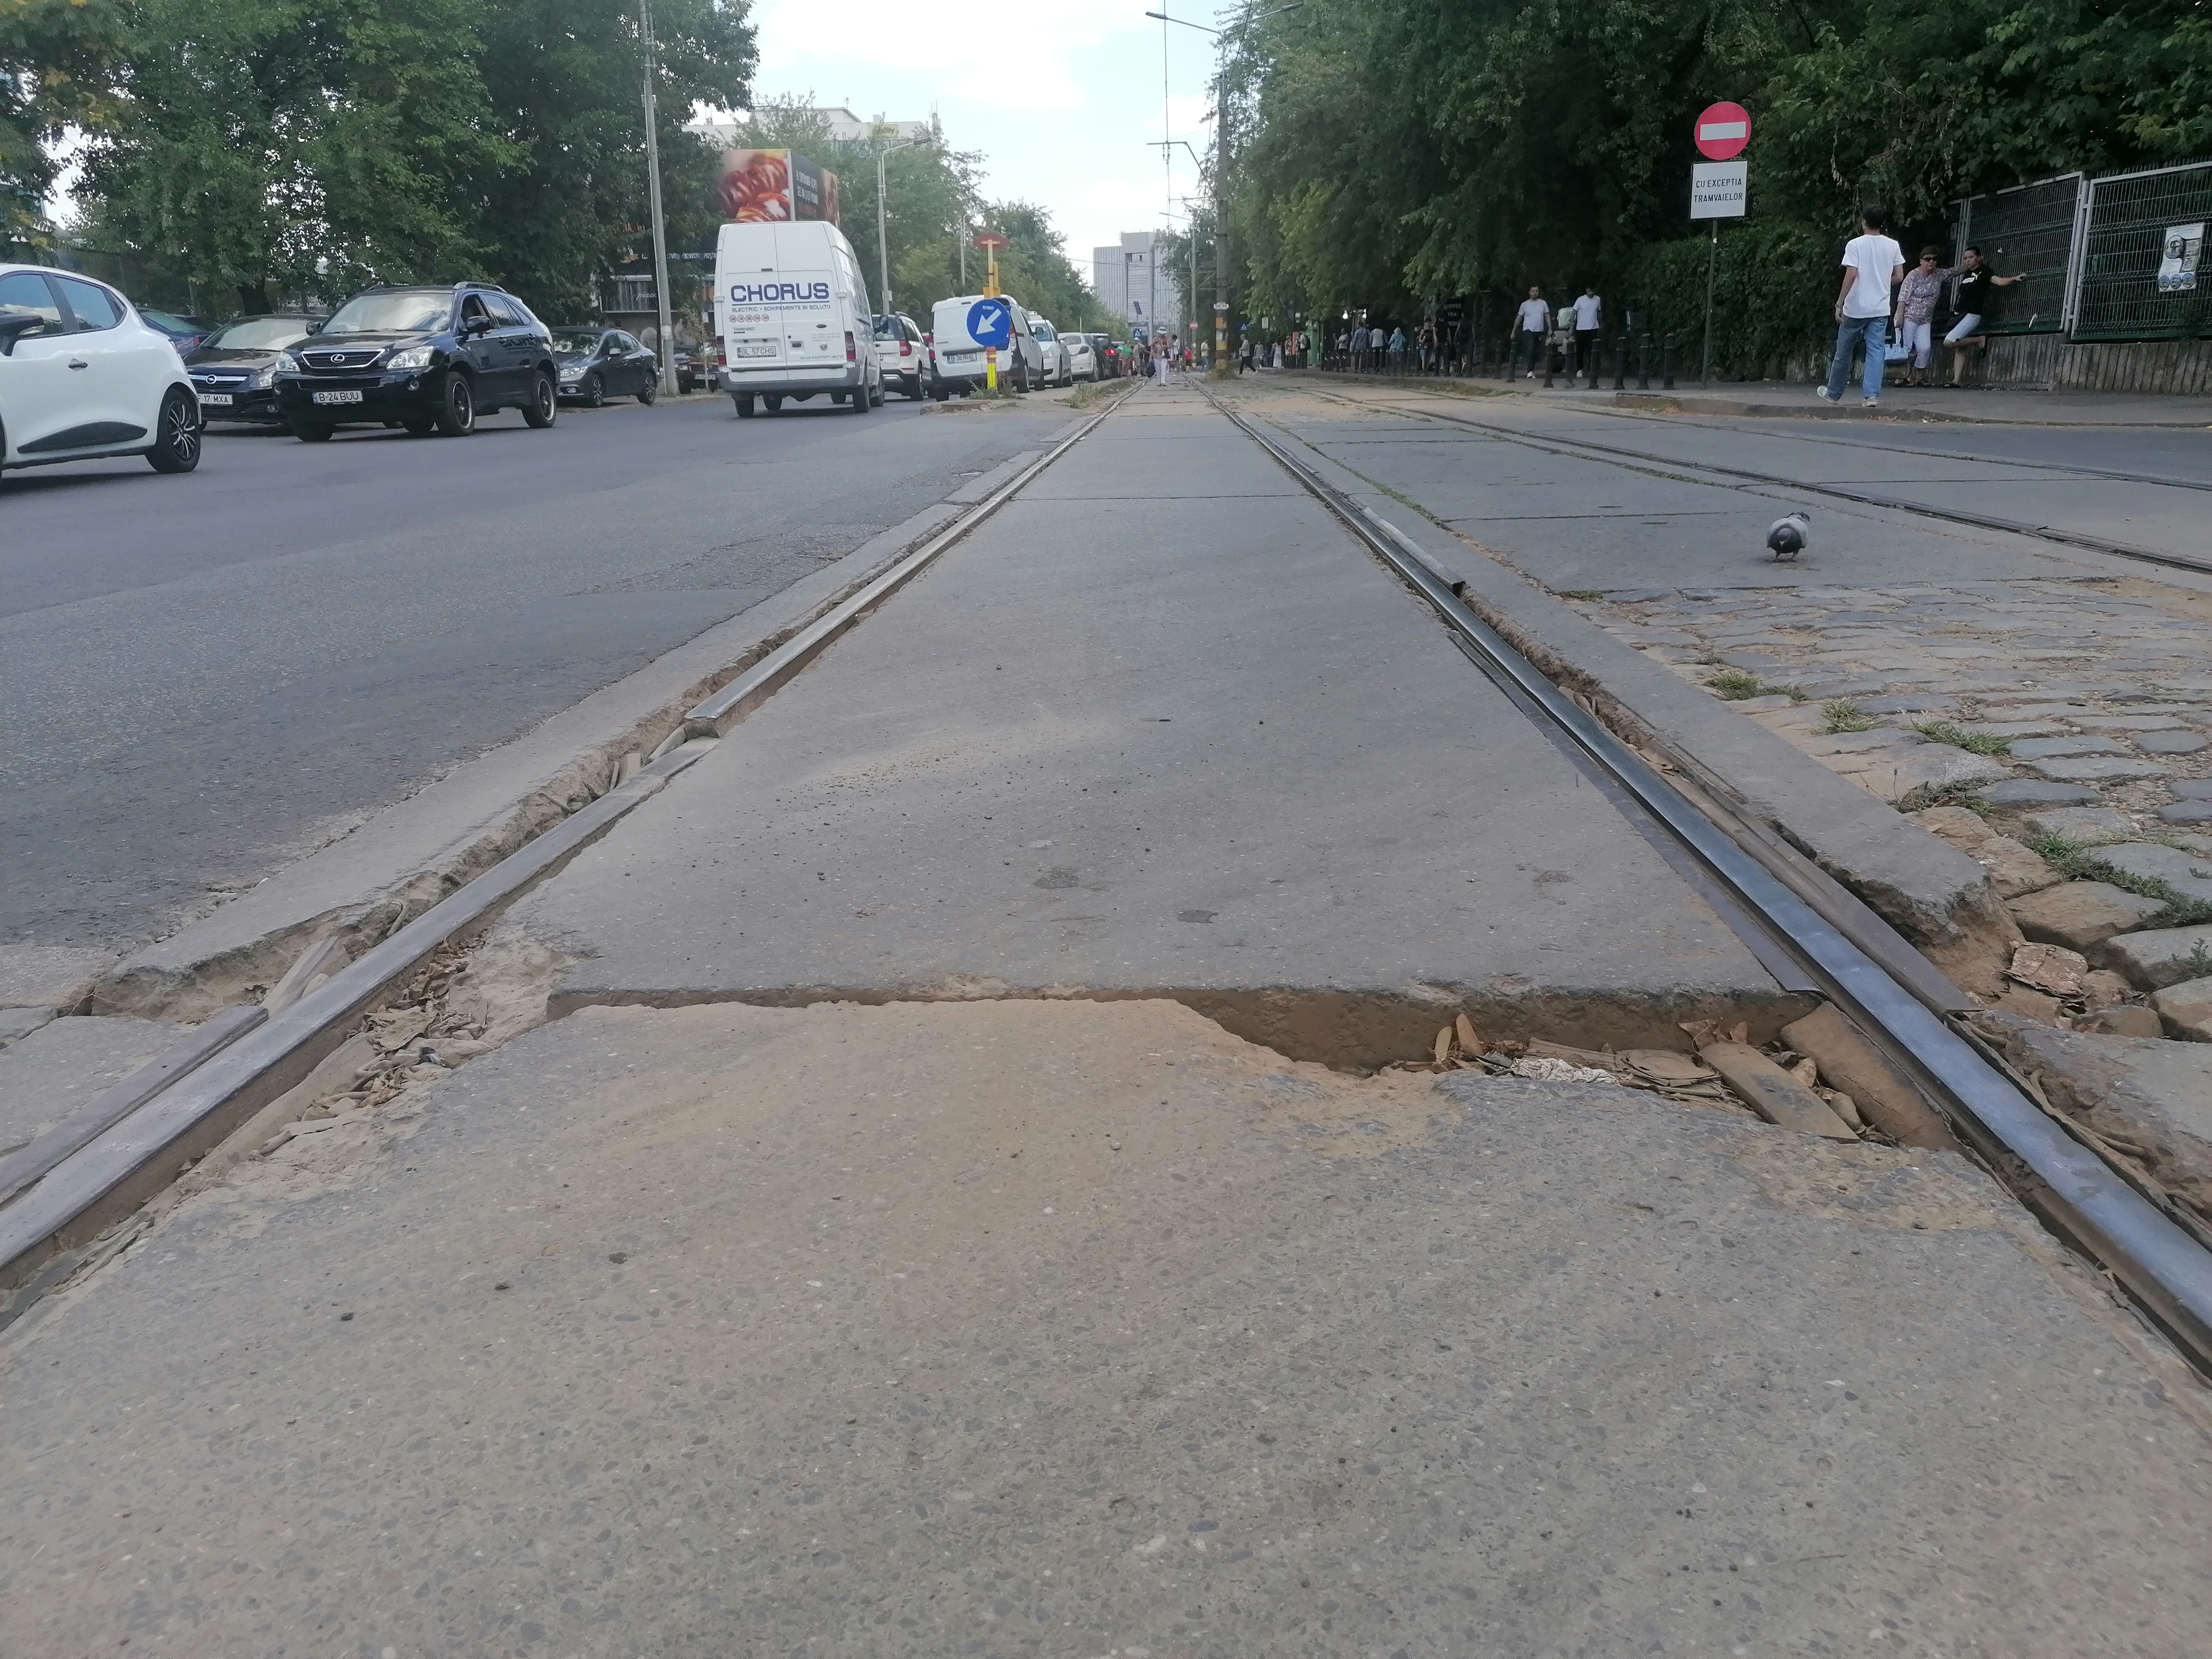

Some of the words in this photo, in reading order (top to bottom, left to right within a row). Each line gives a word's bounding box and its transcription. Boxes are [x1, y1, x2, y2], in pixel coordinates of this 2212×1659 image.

[1696, 180, 1705, 188] CU
[1707, 178, 1742, 187] EXCEPTIA
[1694, 192, 1743, 202] TRAMVAIELOR
[731, 283, 830, 302] CHORUS
[319, 393, 325, 401] B
[328, 393, 338, 401] 24
[340, 392, 358, 401] BUU
